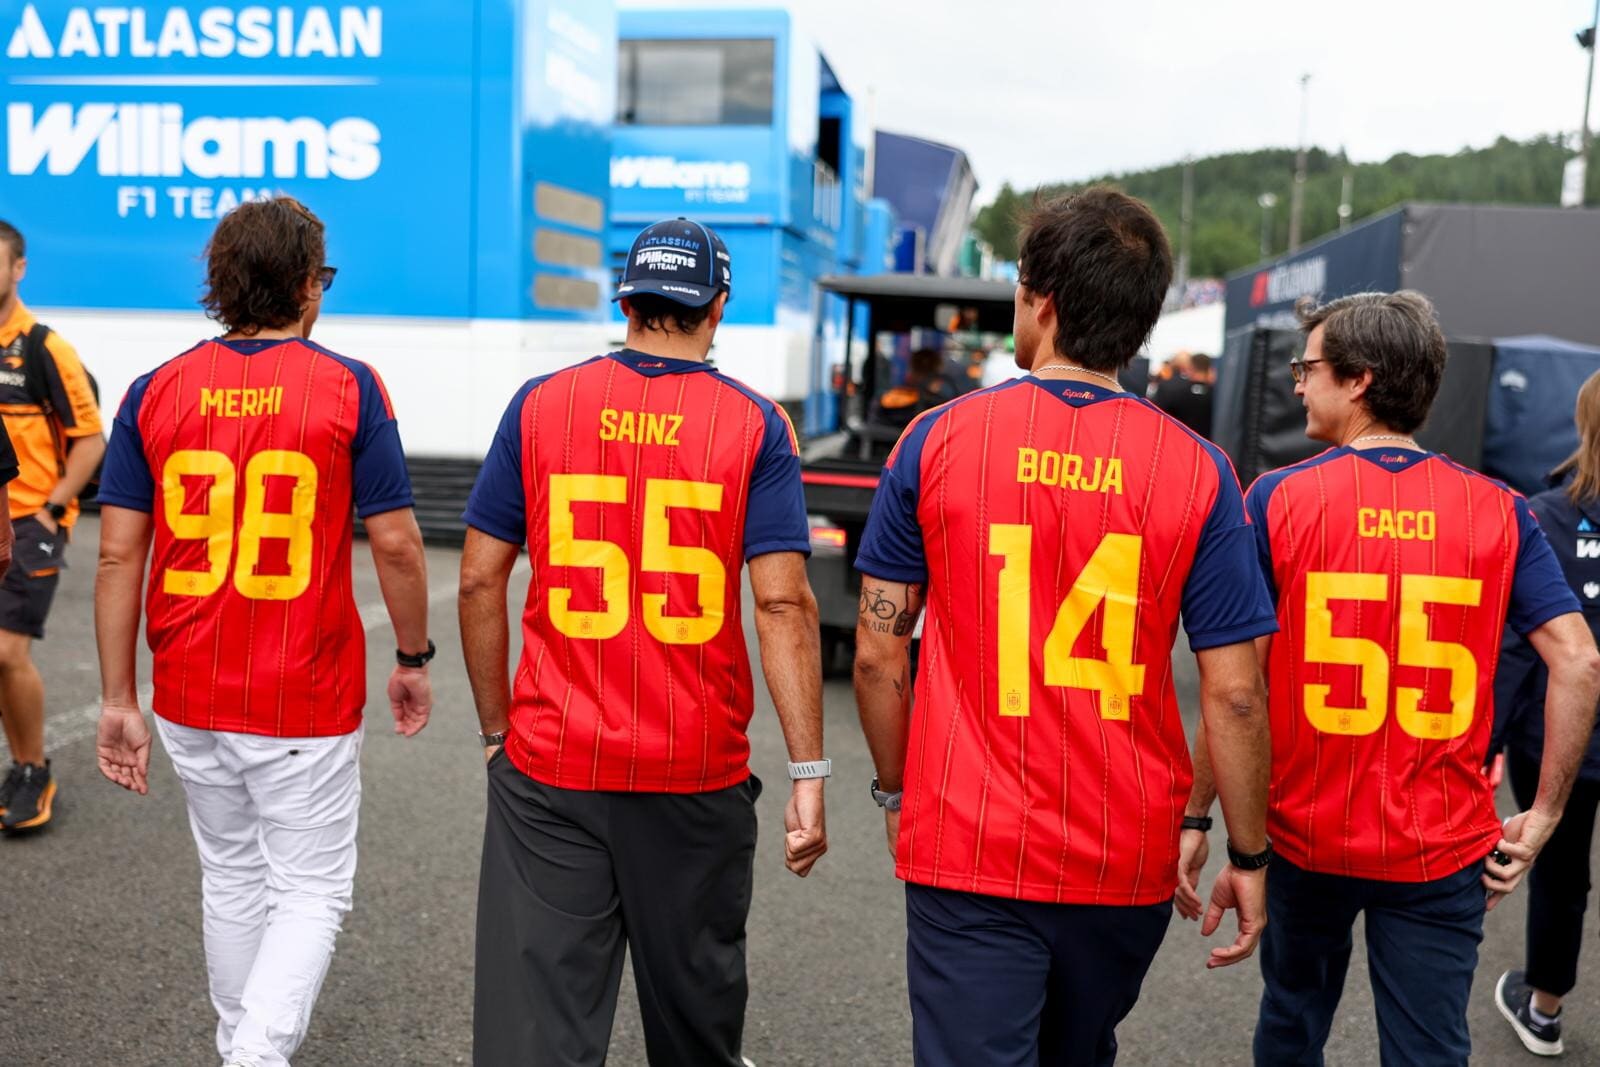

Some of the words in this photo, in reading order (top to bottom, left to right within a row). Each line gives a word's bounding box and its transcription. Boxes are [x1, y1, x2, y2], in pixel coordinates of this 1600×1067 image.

[59, 7, 382, 58] ATLASSIAN
[7, 103, 381, 180] Williams
[118, 186, 156, 217] F1
[635, 251, 696, 269] Williams
[648, 263, 656, 271] F1
[657, 263, 677, 272] TEAM
[200, 386, 284, 417] MERHI
[599, 408, 684, 446] SAINZ
[1016, 447, 1123, 495] BORJA
[162, 449, 318, 600] 98
[1357, 507, 1436, 541] CACO
[548, 473, 726, 645] 55
[988, 523, 1146, 721] 14
[1304, 572, 1483, 740] 55
